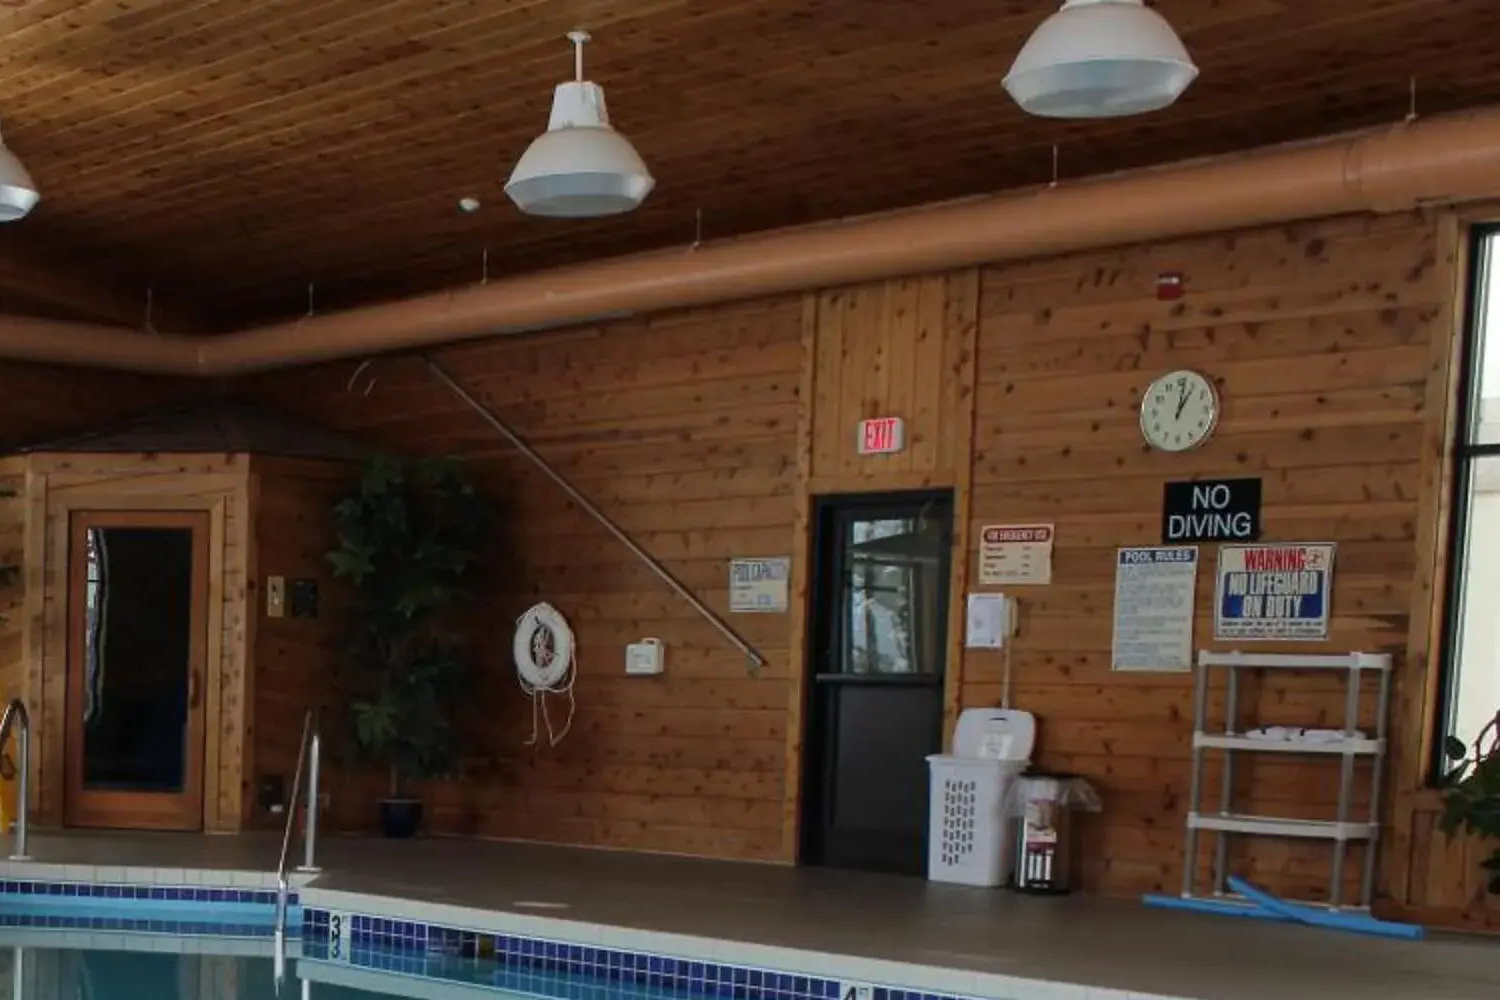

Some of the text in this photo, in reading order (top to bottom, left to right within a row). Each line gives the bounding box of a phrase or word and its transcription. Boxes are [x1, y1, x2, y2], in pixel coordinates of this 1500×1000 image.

[865, 419, 896, 450] EXIT
[1191, 484, 1231, 510] NO
[1168, 512, 1252, 538] DIVING
[1125, 549, 1191, 562] POOL RULES
[1244, 548, 1306, 571] WARNING
[1228, 571, 1318, 596] NO LIFEGUARD
[1242, 595, 1303, 618] ON DUTY
